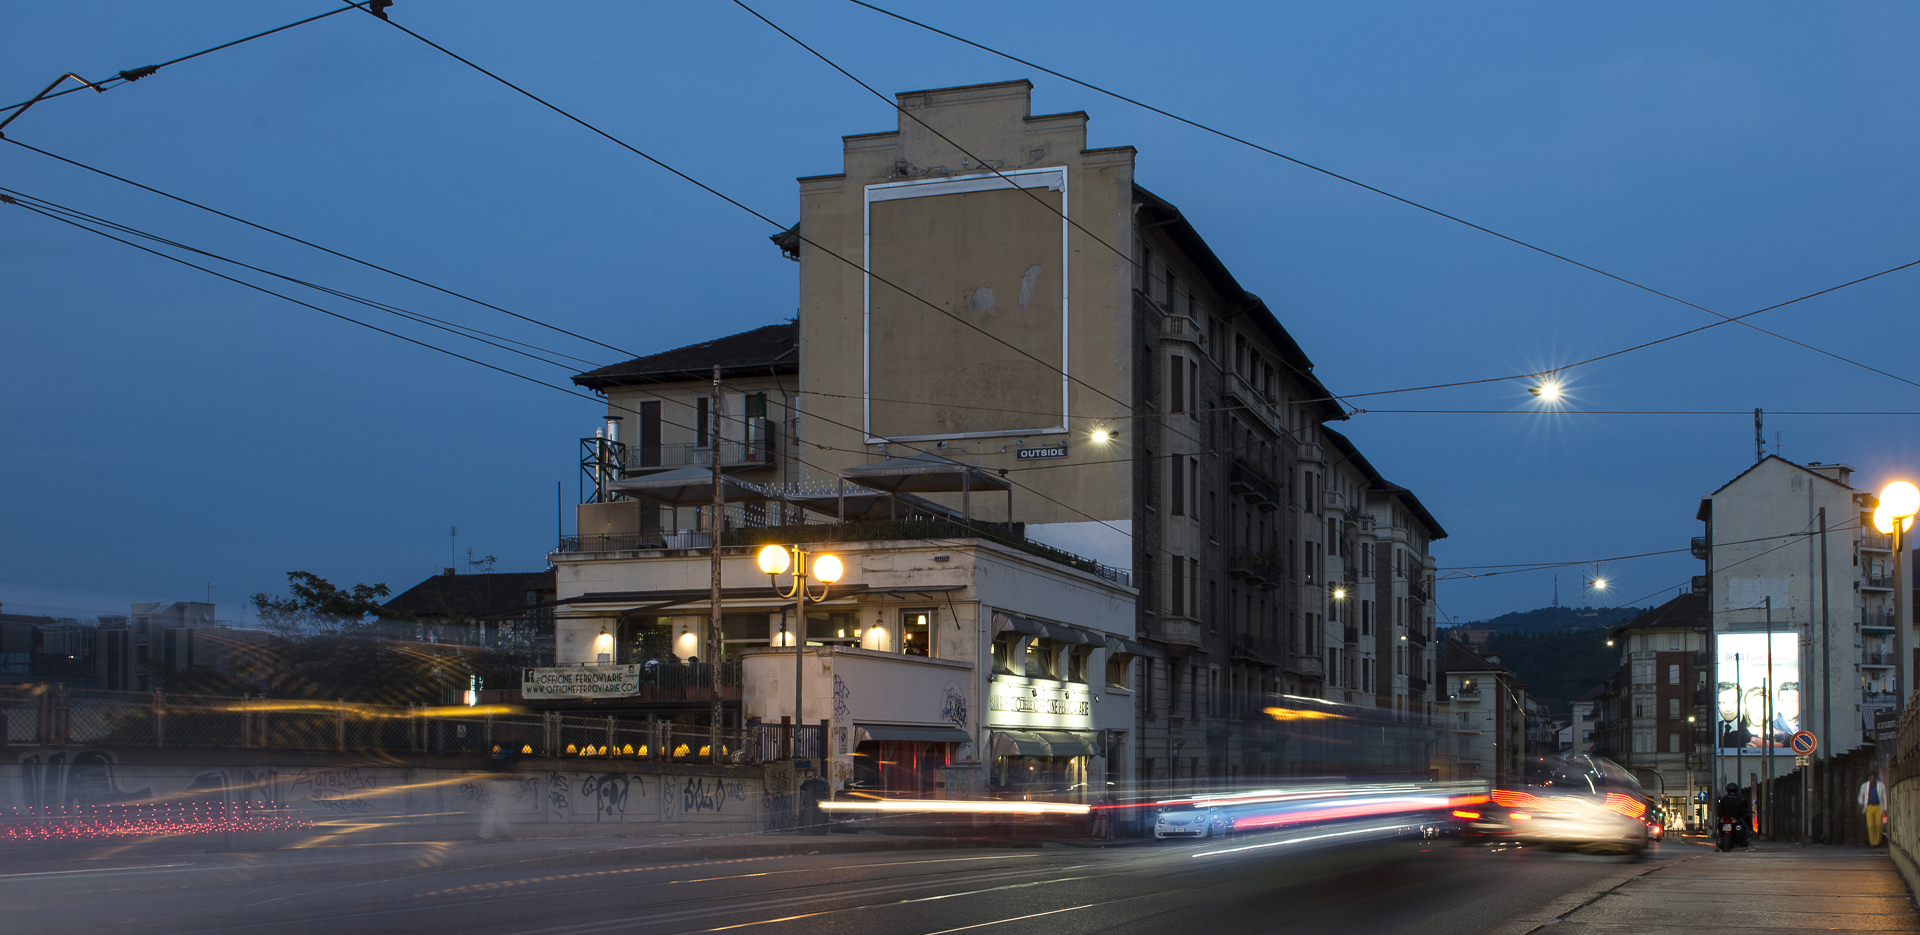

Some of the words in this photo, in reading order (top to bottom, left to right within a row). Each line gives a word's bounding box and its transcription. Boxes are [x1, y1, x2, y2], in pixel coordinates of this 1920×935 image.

[1021, 448, 1064, 458] OUTSIDE
[575, 672, 623, 683] FERROVIARIE
[526, 683, 639, 694] WWW.OFFICINEFERROVIARIE.COM
